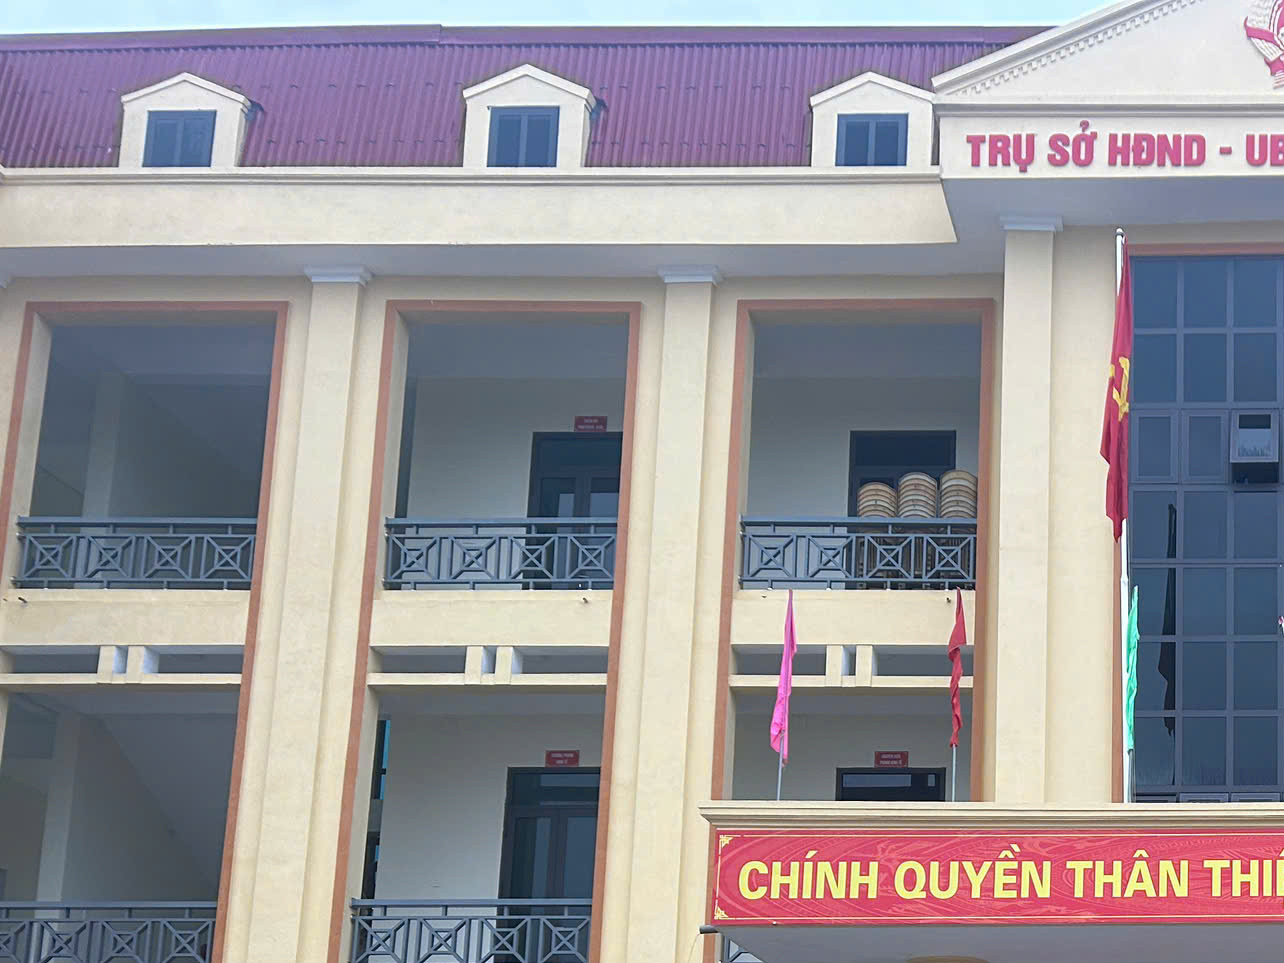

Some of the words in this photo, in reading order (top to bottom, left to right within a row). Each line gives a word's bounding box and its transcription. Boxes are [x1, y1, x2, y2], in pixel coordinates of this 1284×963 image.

[966, 134, 1035, 173] TRỤ
[1047, 120, 1098, 166] SỞ
[1108, 133, 1206, 167] HĐND
[737, 850, 879, 900] CHÍNH
[894, 843, 1052, 900] QUYỀN
[1065, 849, 1189, 898] THÂN
